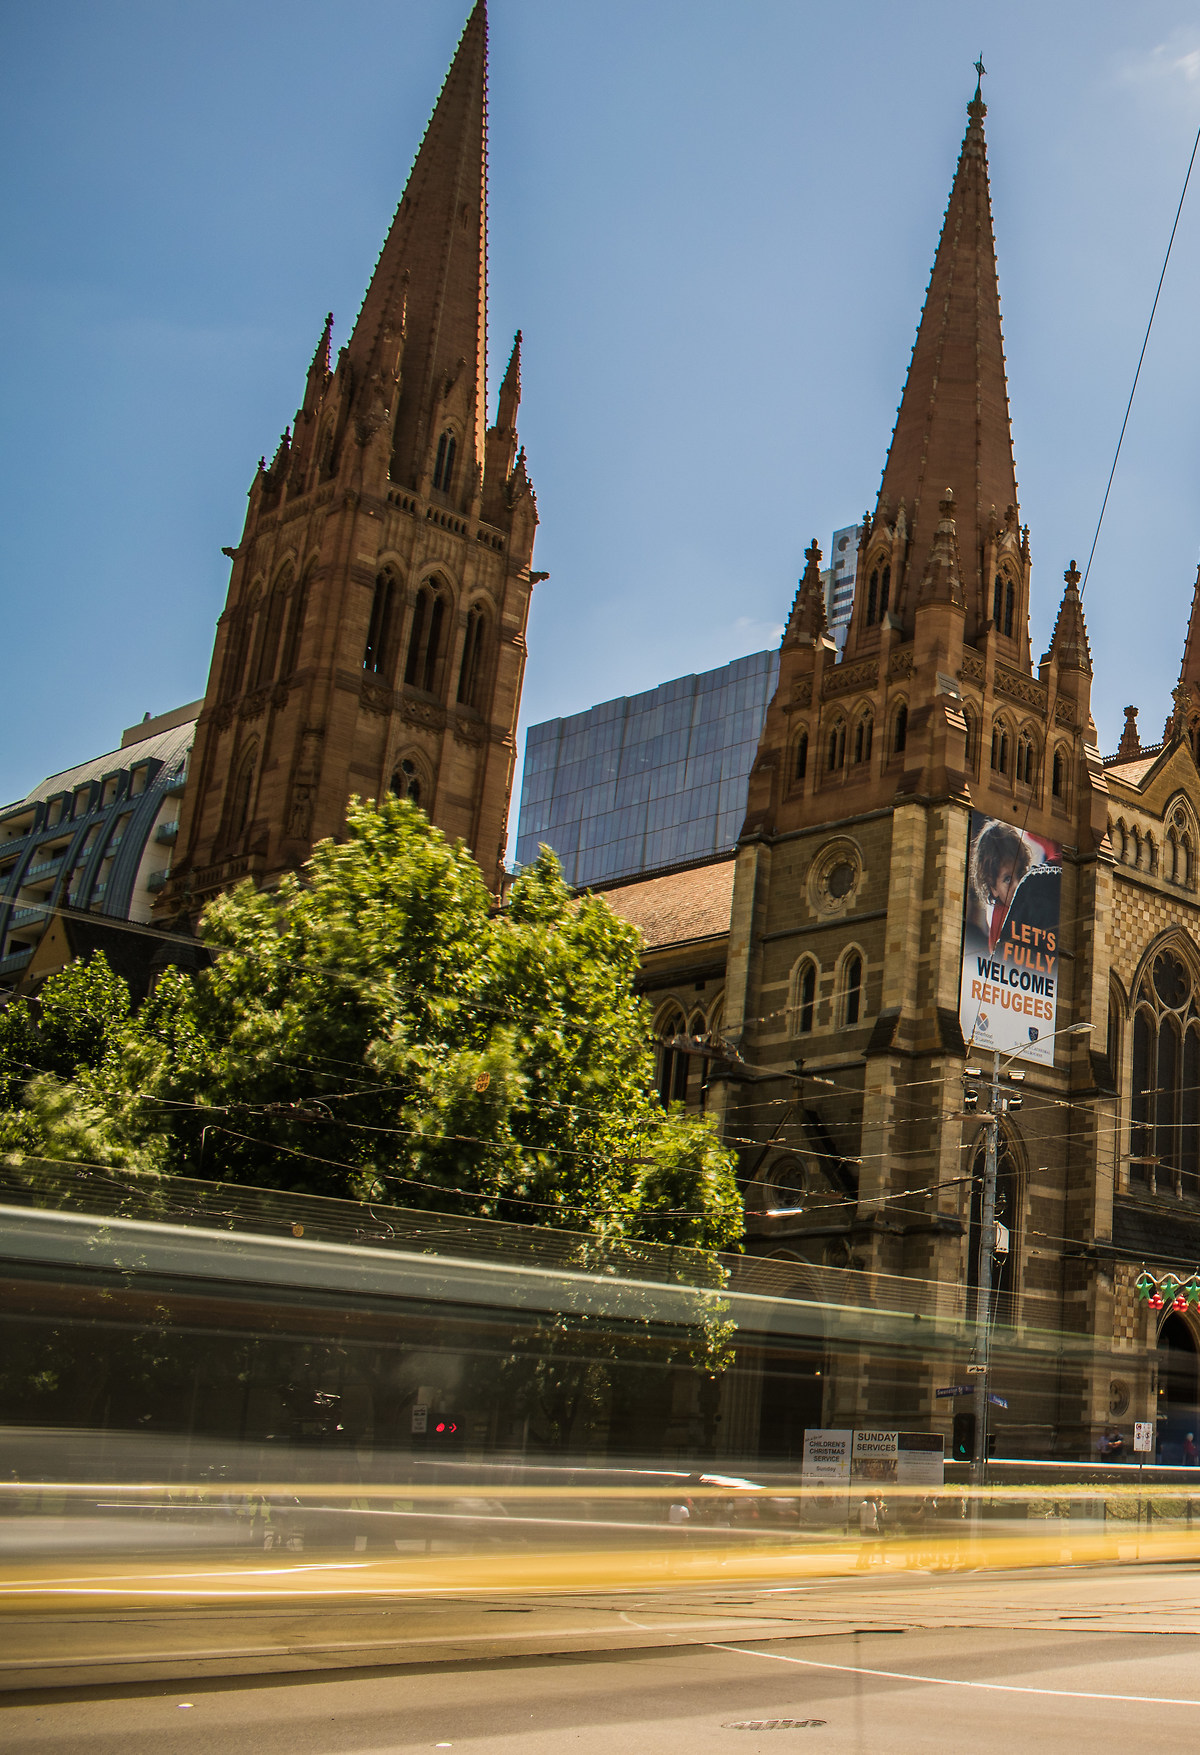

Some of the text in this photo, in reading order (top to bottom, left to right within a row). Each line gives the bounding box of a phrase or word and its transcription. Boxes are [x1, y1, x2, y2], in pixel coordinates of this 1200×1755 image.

[1011, 920, 1056, 952] LET'S
[1004, 942, 1056, 974] FULLY
[977, 956, 1054, 998] WELCOME
[971, 979, 1054, 1021] REFUGEES
[856, 1443, 896, 1452] SERVICES
[857, 1433, 897, 1442] SUNDAY
